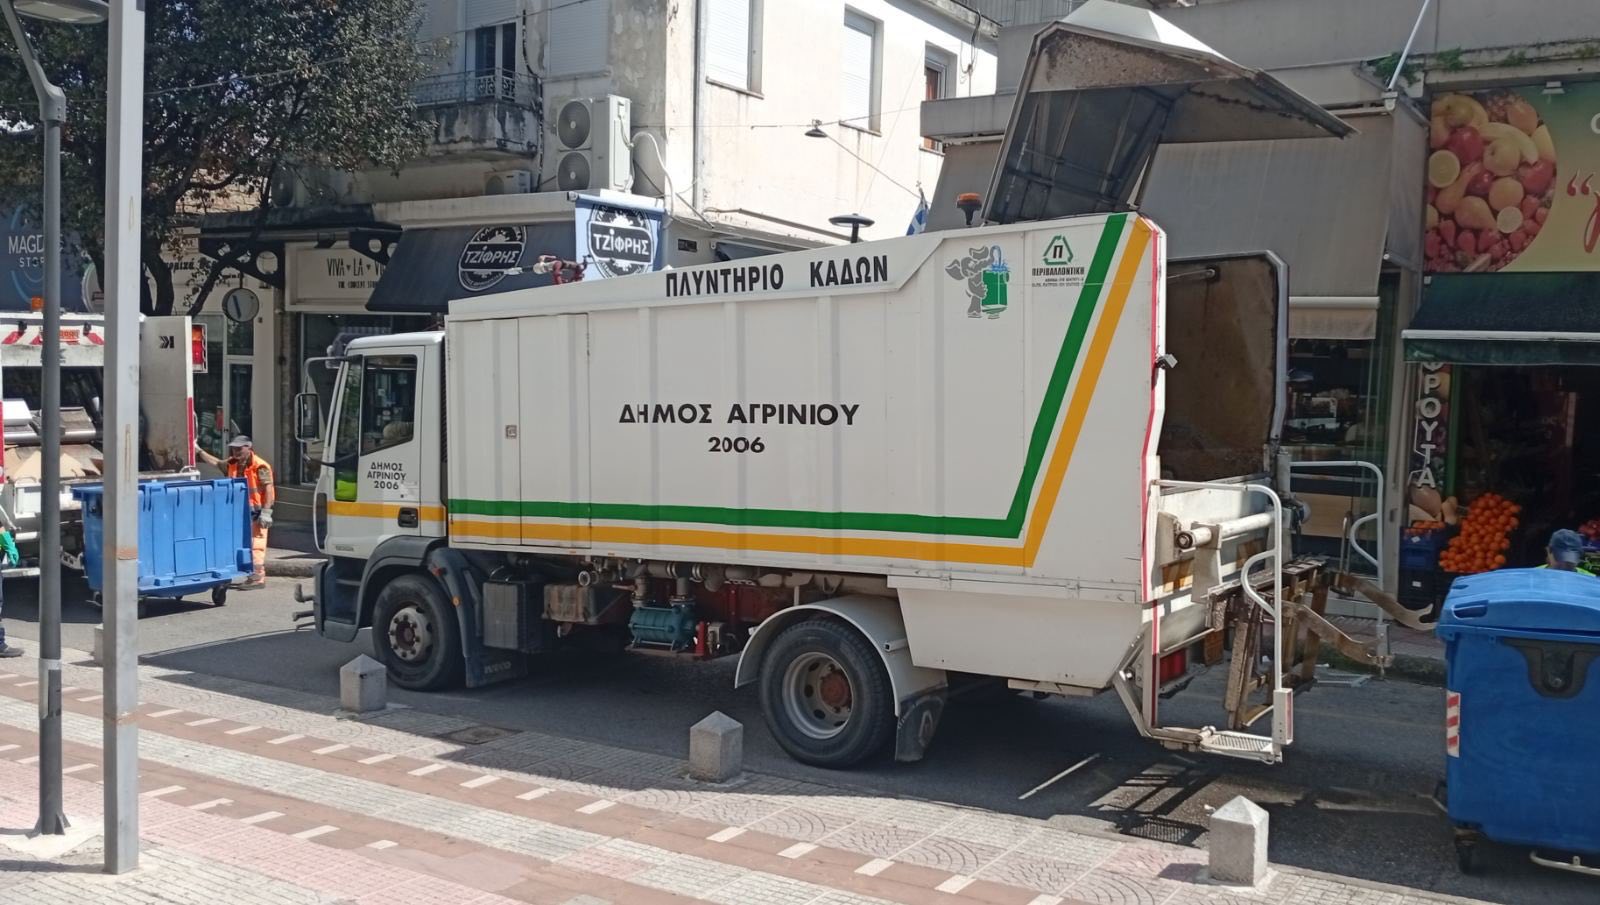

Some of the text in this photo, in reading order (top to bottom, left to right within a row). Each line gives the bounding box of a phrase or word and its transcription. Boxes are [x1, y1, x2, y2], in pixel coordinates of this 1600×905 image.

[353, 258, 364, 276] LA
[666, 263, 784, 297] ΠΛΥΝΤΗΡΙΟ
[810, 255, 888, 287] ΚΑΔΩΝ
[618, 404, 860, 426] ΔΗΜΟΣ ΑΓΡΙΝΙΟΥ
[708, 436, 765, 453] 2006
[370, 461, 404, 472] ΔΗΜΟΣ
[367, 470, 407, 481] ΑΓΡΙΝΙΟΥ
[373, 480, 399, 490] 2006
